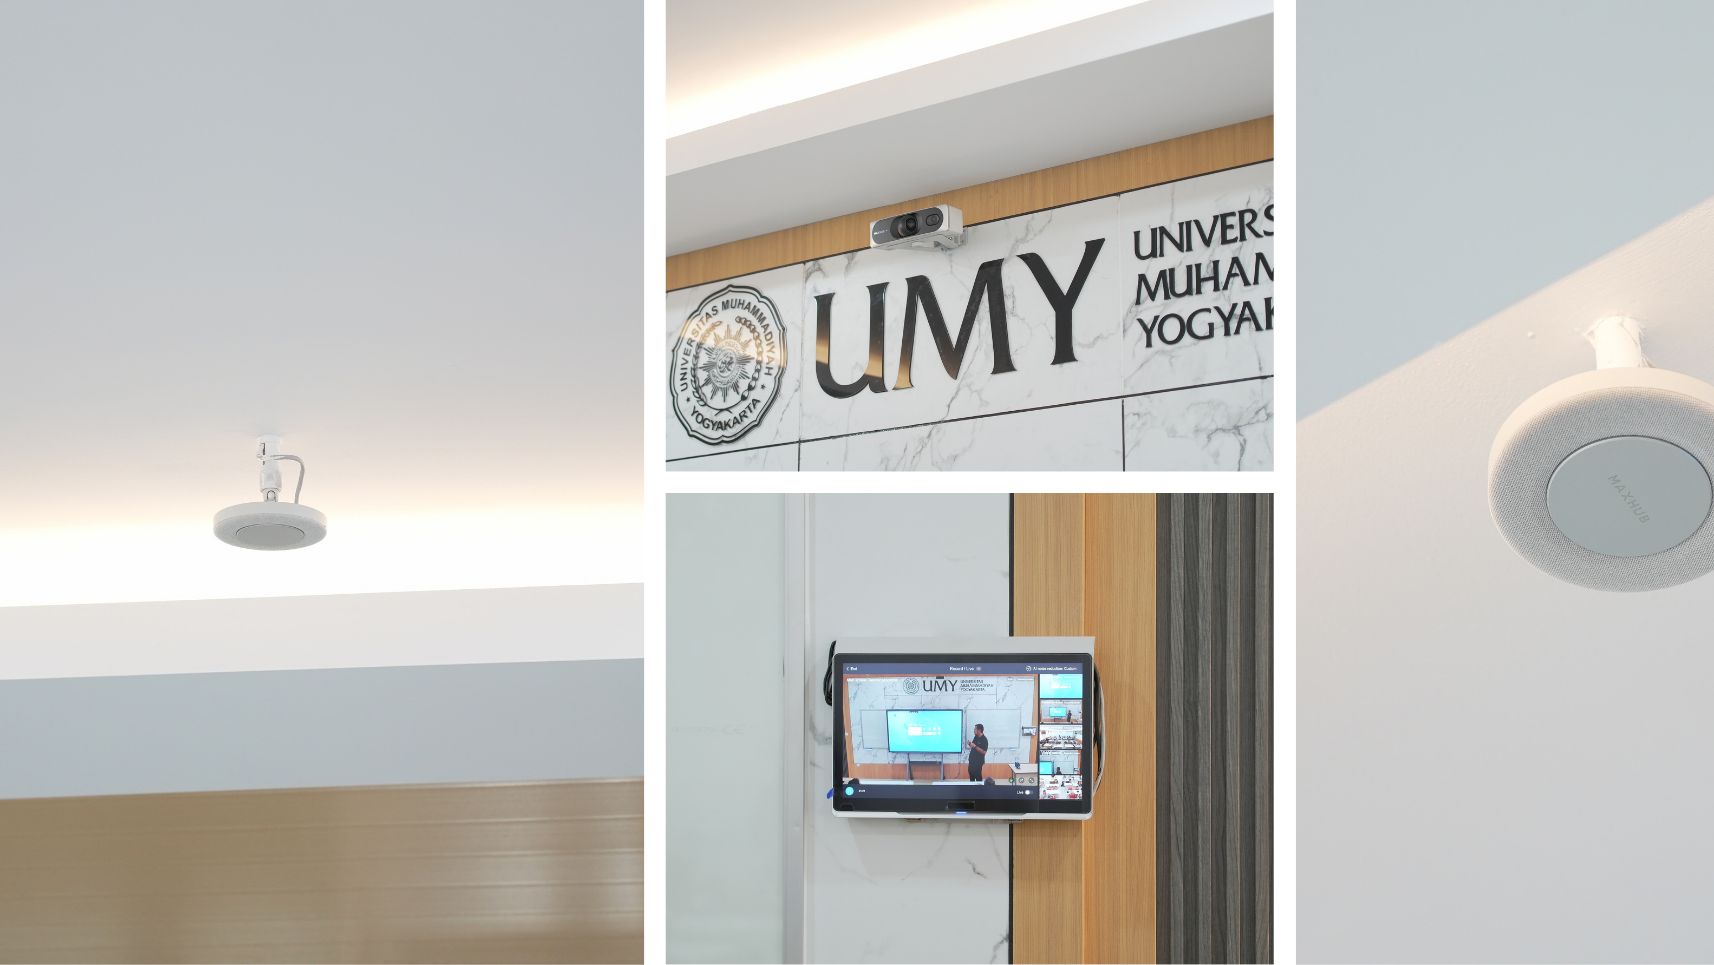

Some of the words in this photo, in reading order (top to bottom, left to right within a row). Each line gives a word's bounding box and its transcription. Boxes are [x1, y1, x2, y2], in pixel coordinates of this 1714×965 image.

[814, 237, 1106, 399] UMY
[679, 305, 719, 392] UNIVERSITAS
[721, 298, 775, 377] MUHAMMADIYAH
[690, 397, 761, 431] YOGYAKARTA
[1607, 473, 1650, 524] MAXHUB
[922, 679, 958, 692] UMY
